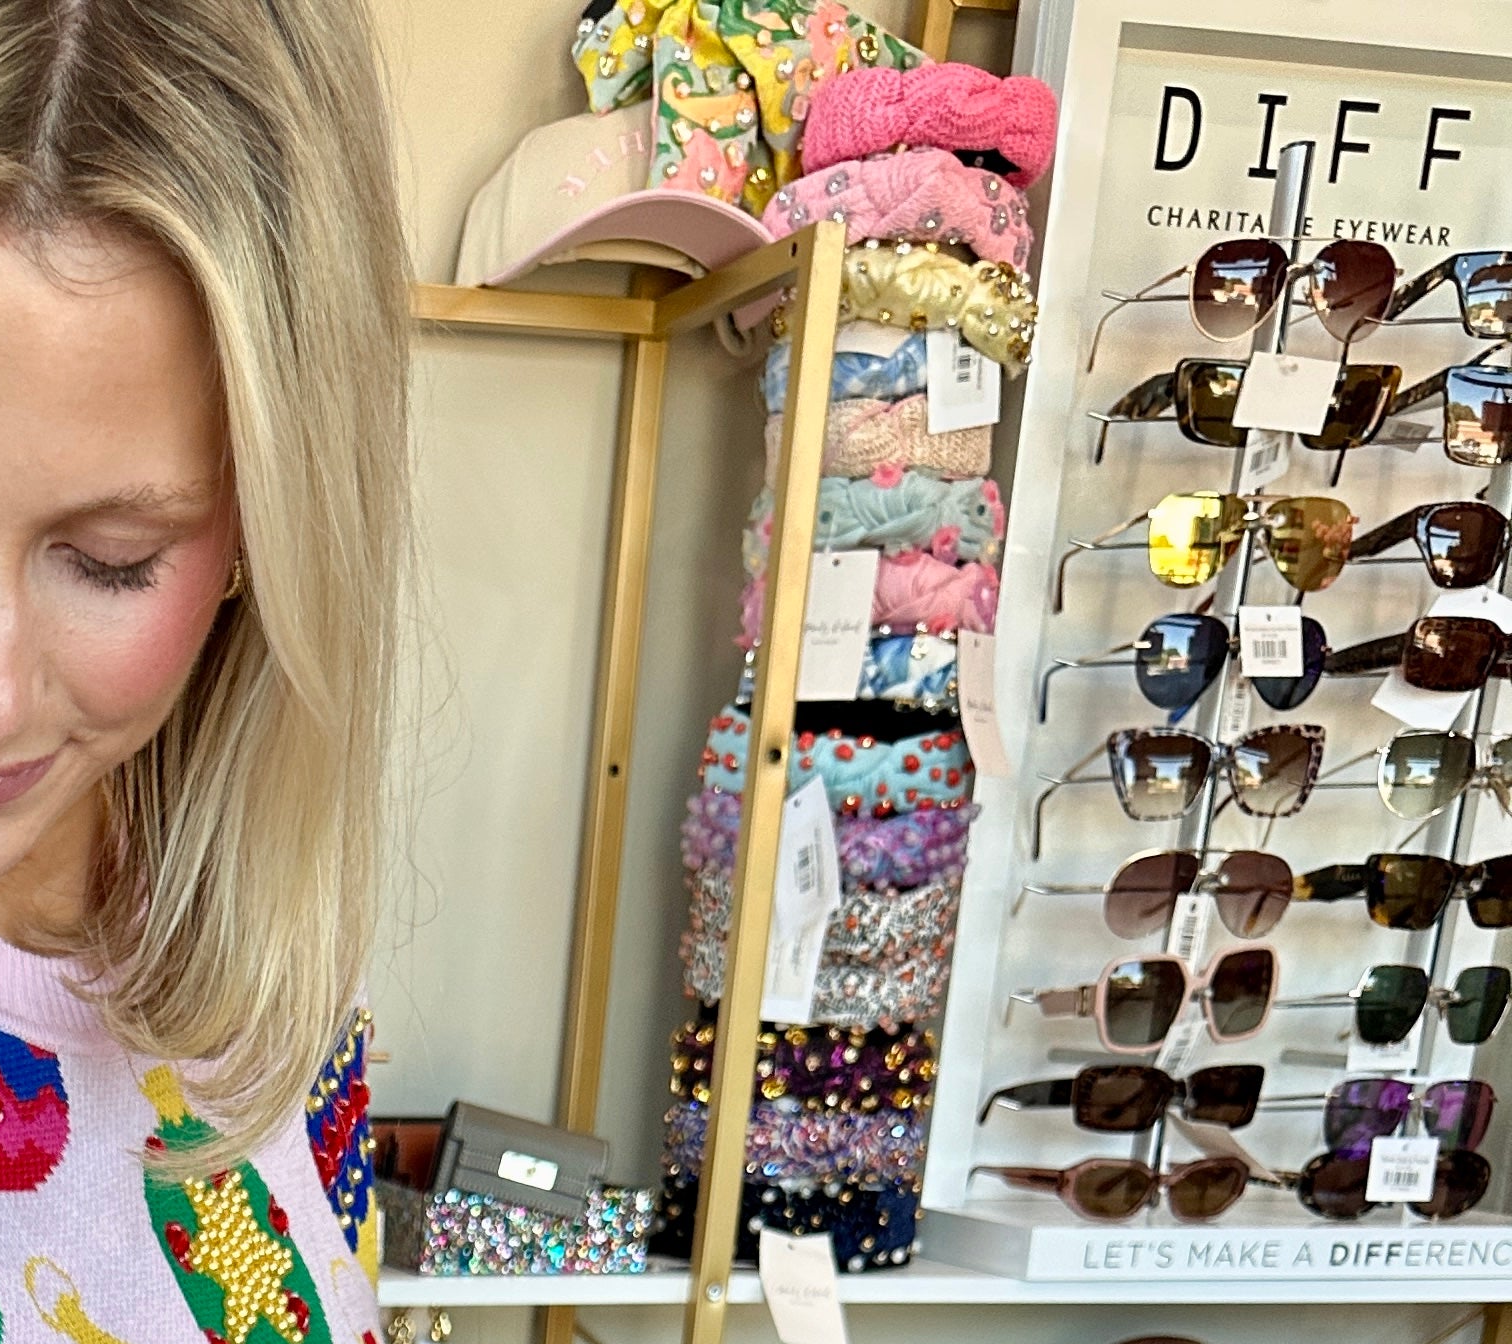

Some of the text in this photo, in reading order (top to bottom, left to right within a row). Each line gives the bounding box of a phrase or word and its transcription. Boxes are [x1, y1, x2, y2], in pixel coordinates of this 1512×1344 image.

[1153, 85, 1472, 191] DIFF
[1146, 205, 1452, 248] CHARITAE EYEWEAR
[1083, 1239, 1512, 1270] LET'S MAKE A DIFFERENC
